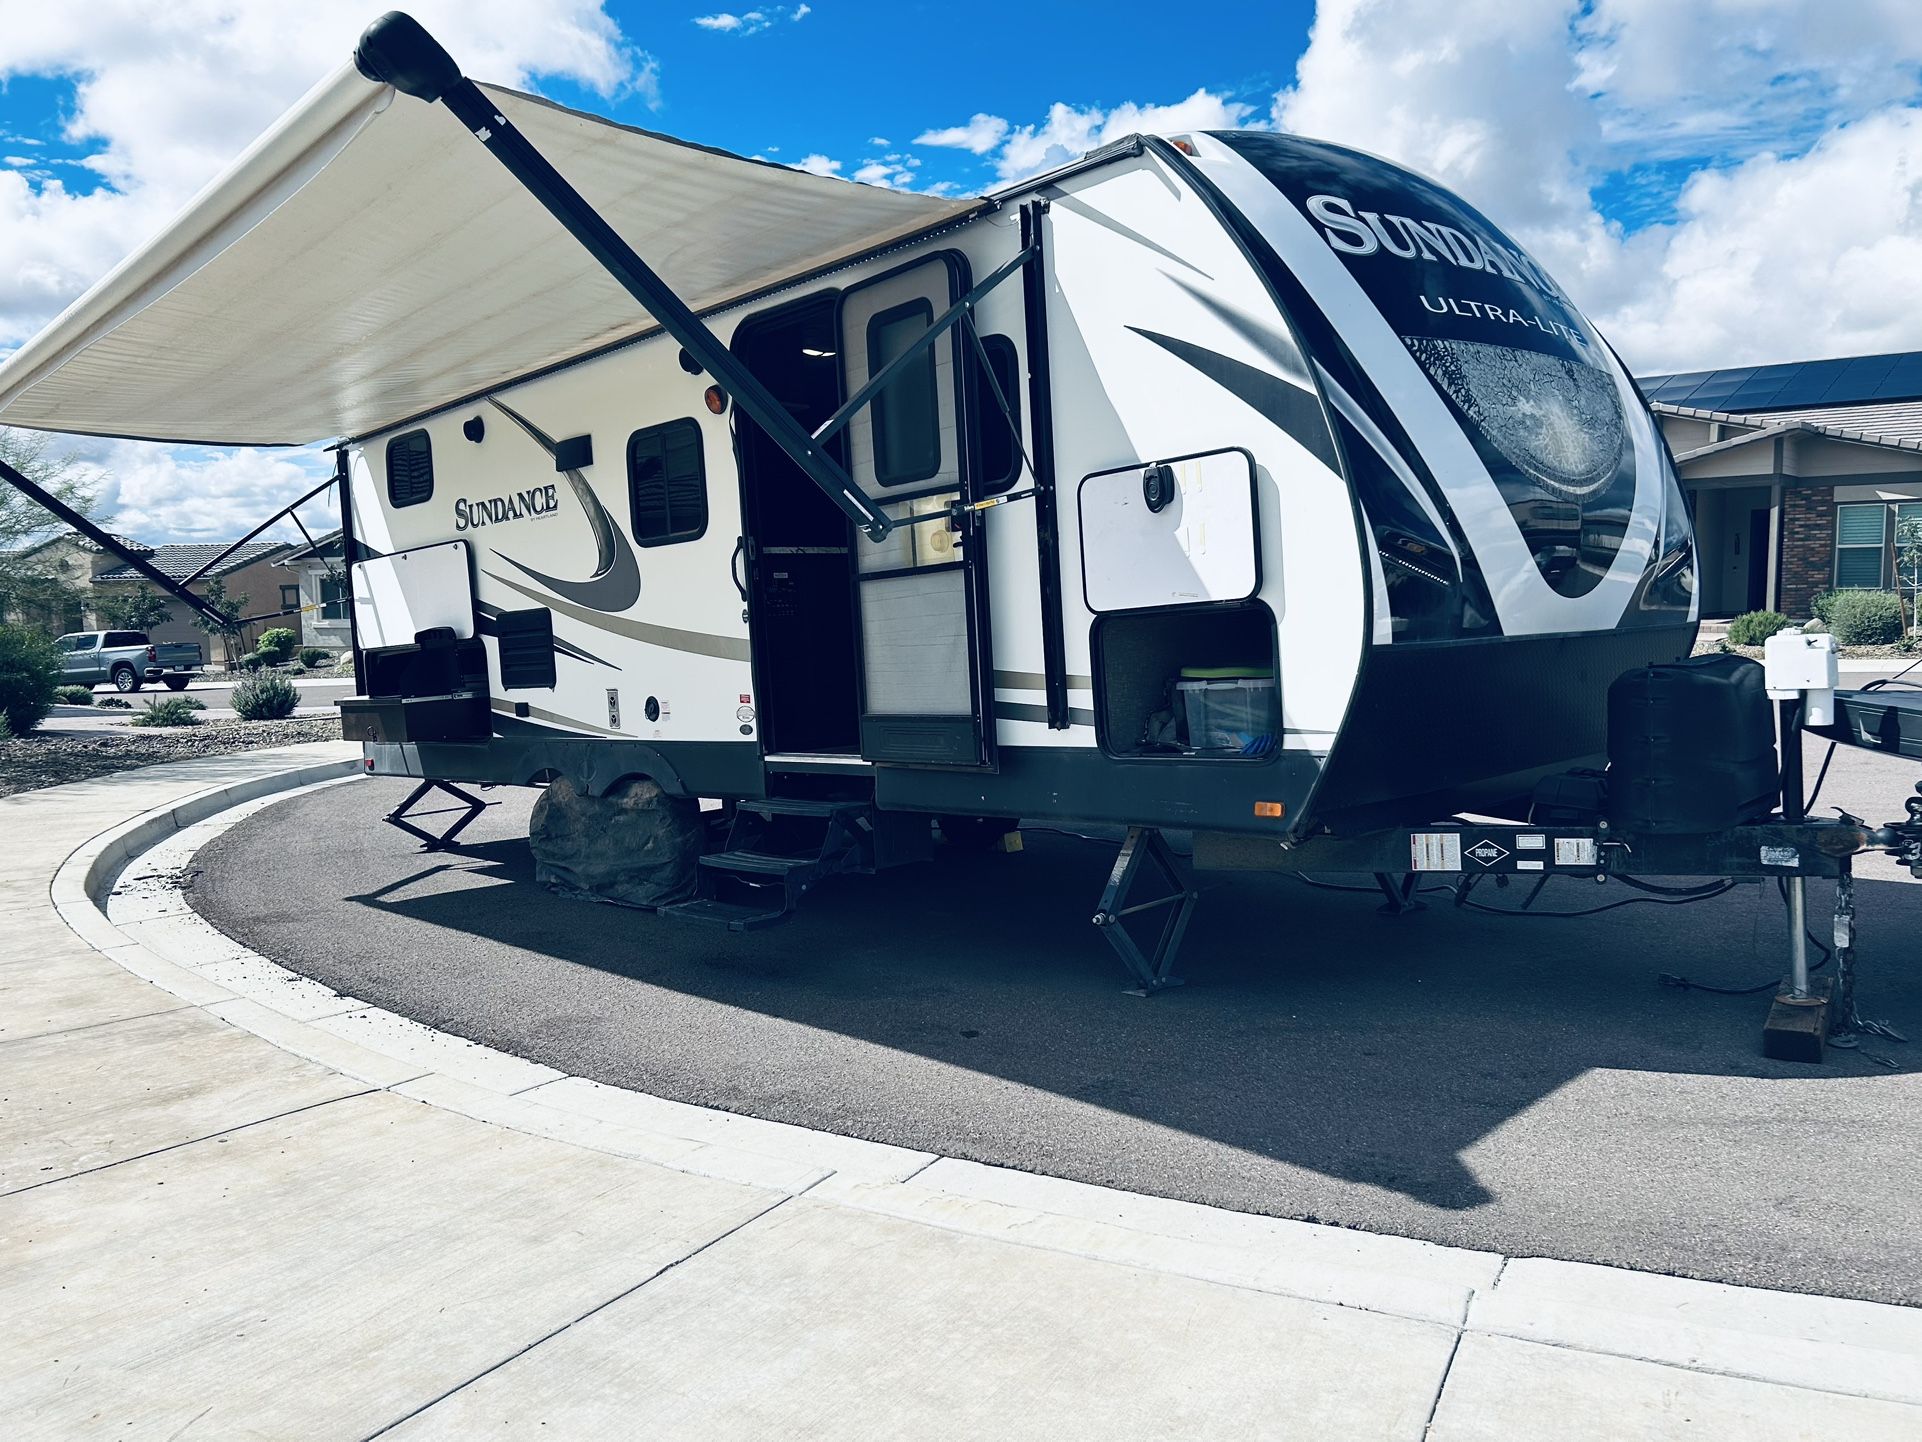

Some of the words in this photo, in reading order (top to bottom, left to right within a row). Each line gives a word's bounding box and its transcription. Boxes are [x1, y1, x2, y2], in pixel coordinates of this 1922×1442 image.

[1306, 195, 1577, 308] SUNDANC
[1419, 295, 1588, 347] ULTRA-LITE
[454, 484, 559, 532] SUNDANCE
[1475, 848, 1498, 857] PROPANE
